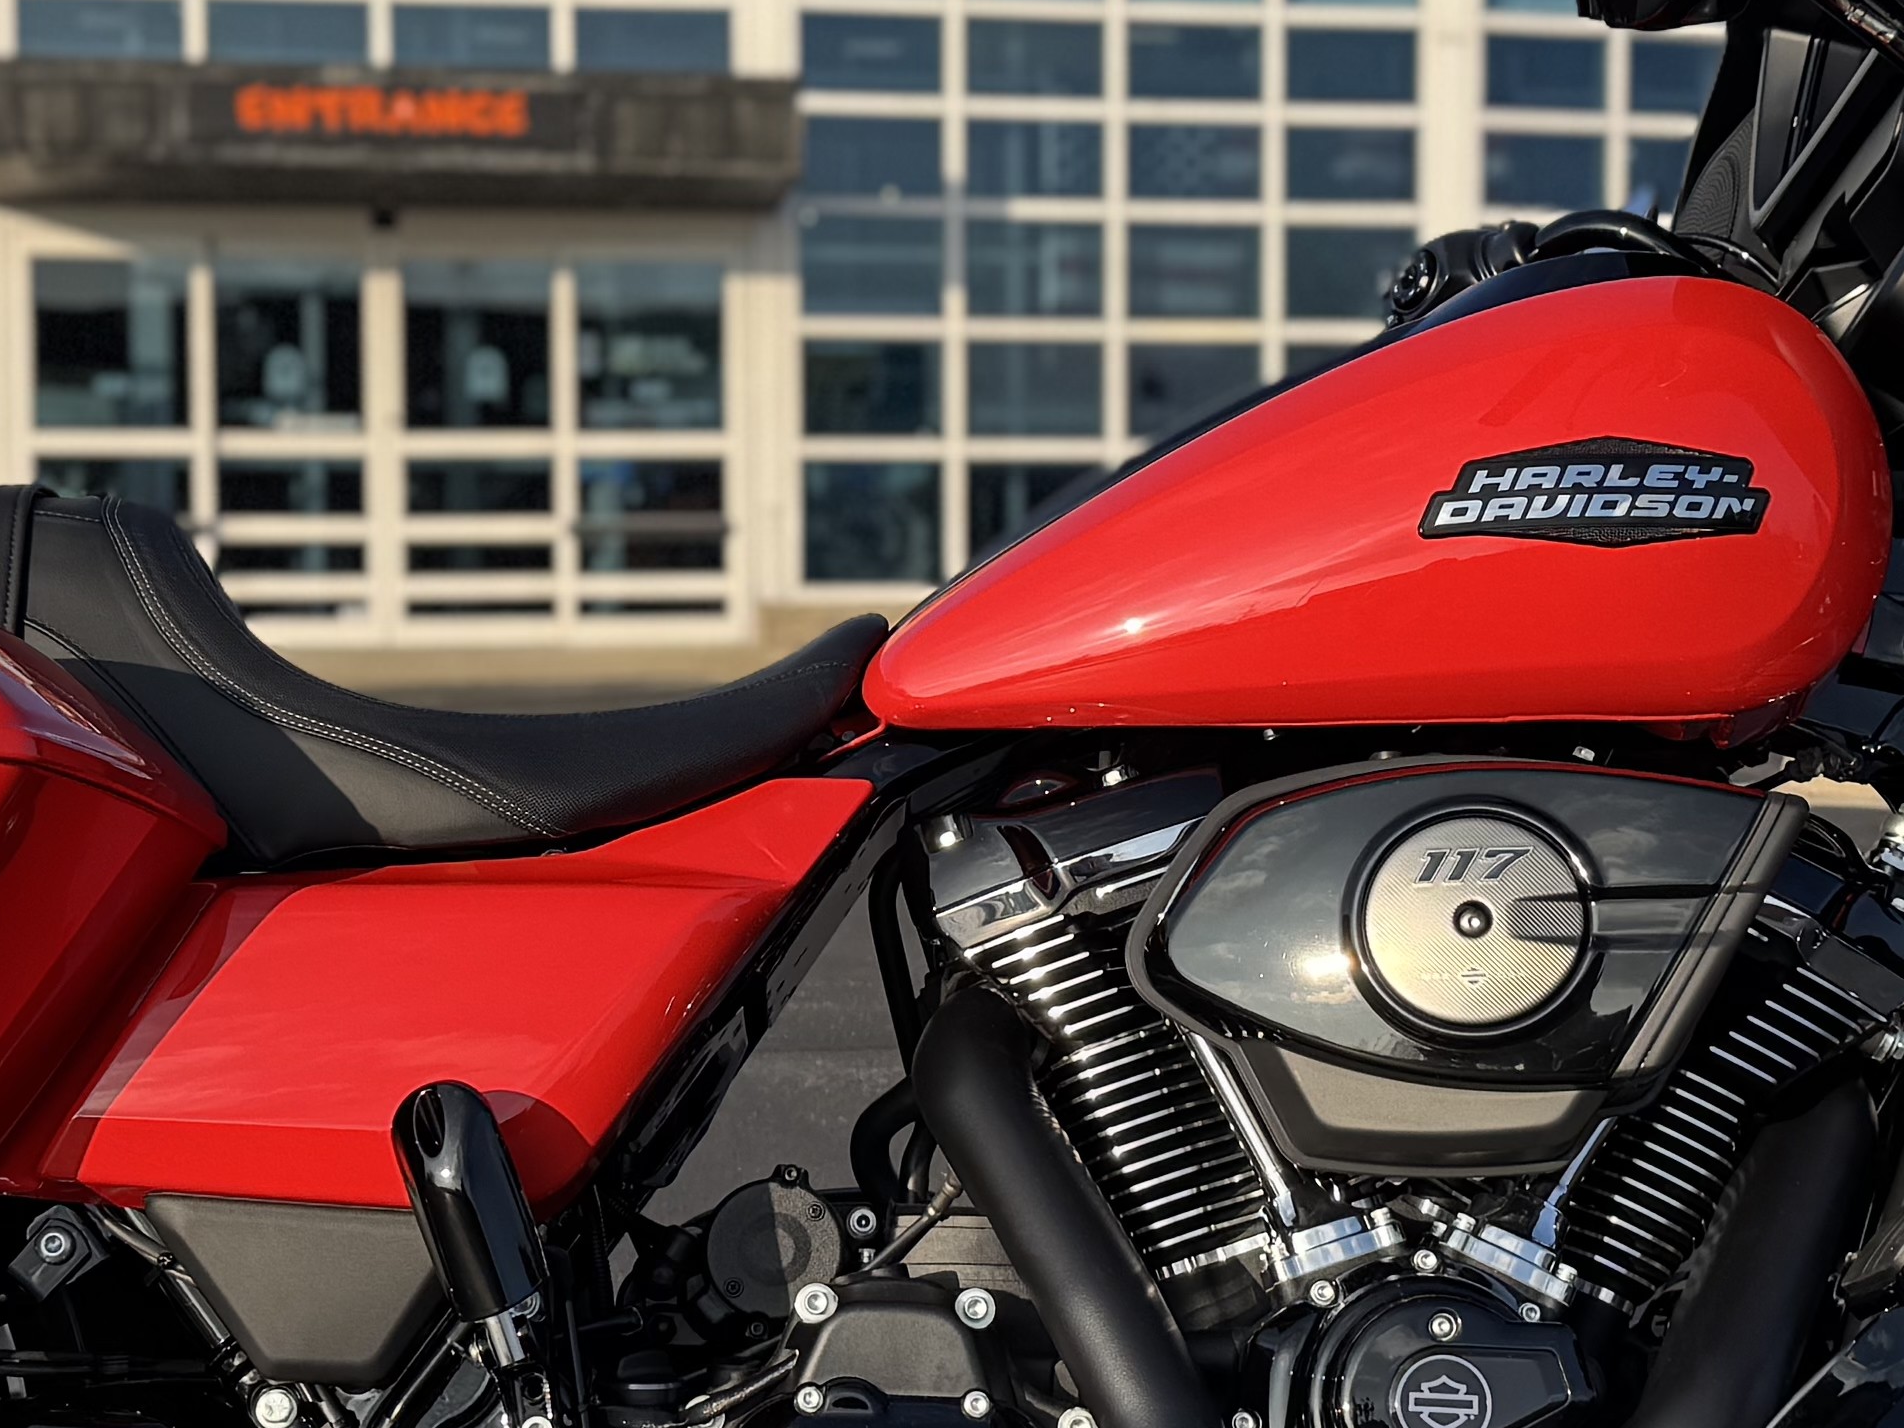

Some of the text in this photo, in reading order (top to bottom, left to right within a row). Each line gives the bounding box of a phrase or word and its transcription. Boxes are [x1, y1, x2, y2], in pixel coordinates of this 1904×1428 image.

[235, 82, 530, 138] ENTRANCE
[1468, 464, 1739, 494] HARLEY-
[1434, 493, 1756, 527] DAVIDSON
[1414, 845, 1535, 885] 117
